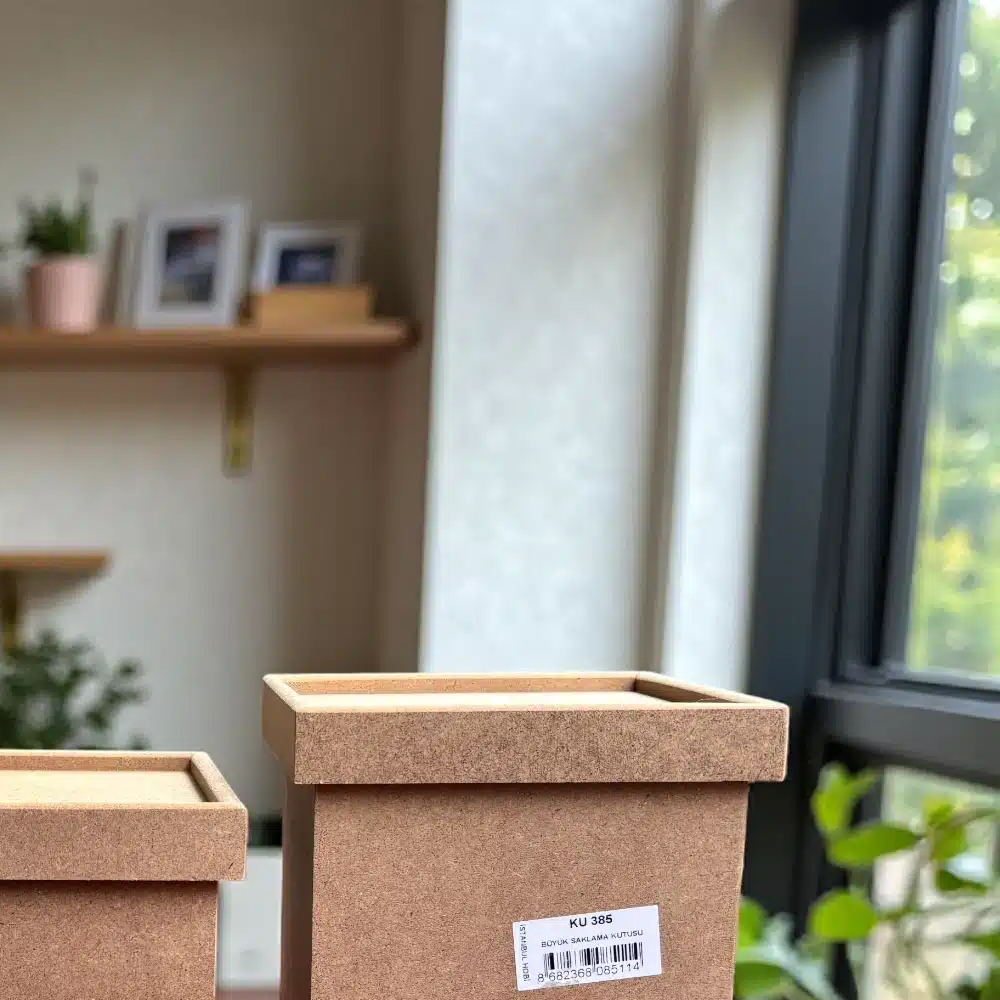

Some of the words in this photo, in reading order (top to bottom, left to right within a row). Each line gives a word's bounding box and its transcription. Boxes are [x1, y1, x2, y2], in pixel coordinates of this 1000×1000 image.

[570, 917, 587, 928] KU
[591, 914, 613, 926] 385
[571, 934, 608, 944] SAKLAMA
[611, 929, 644, 939] KUTUSU
